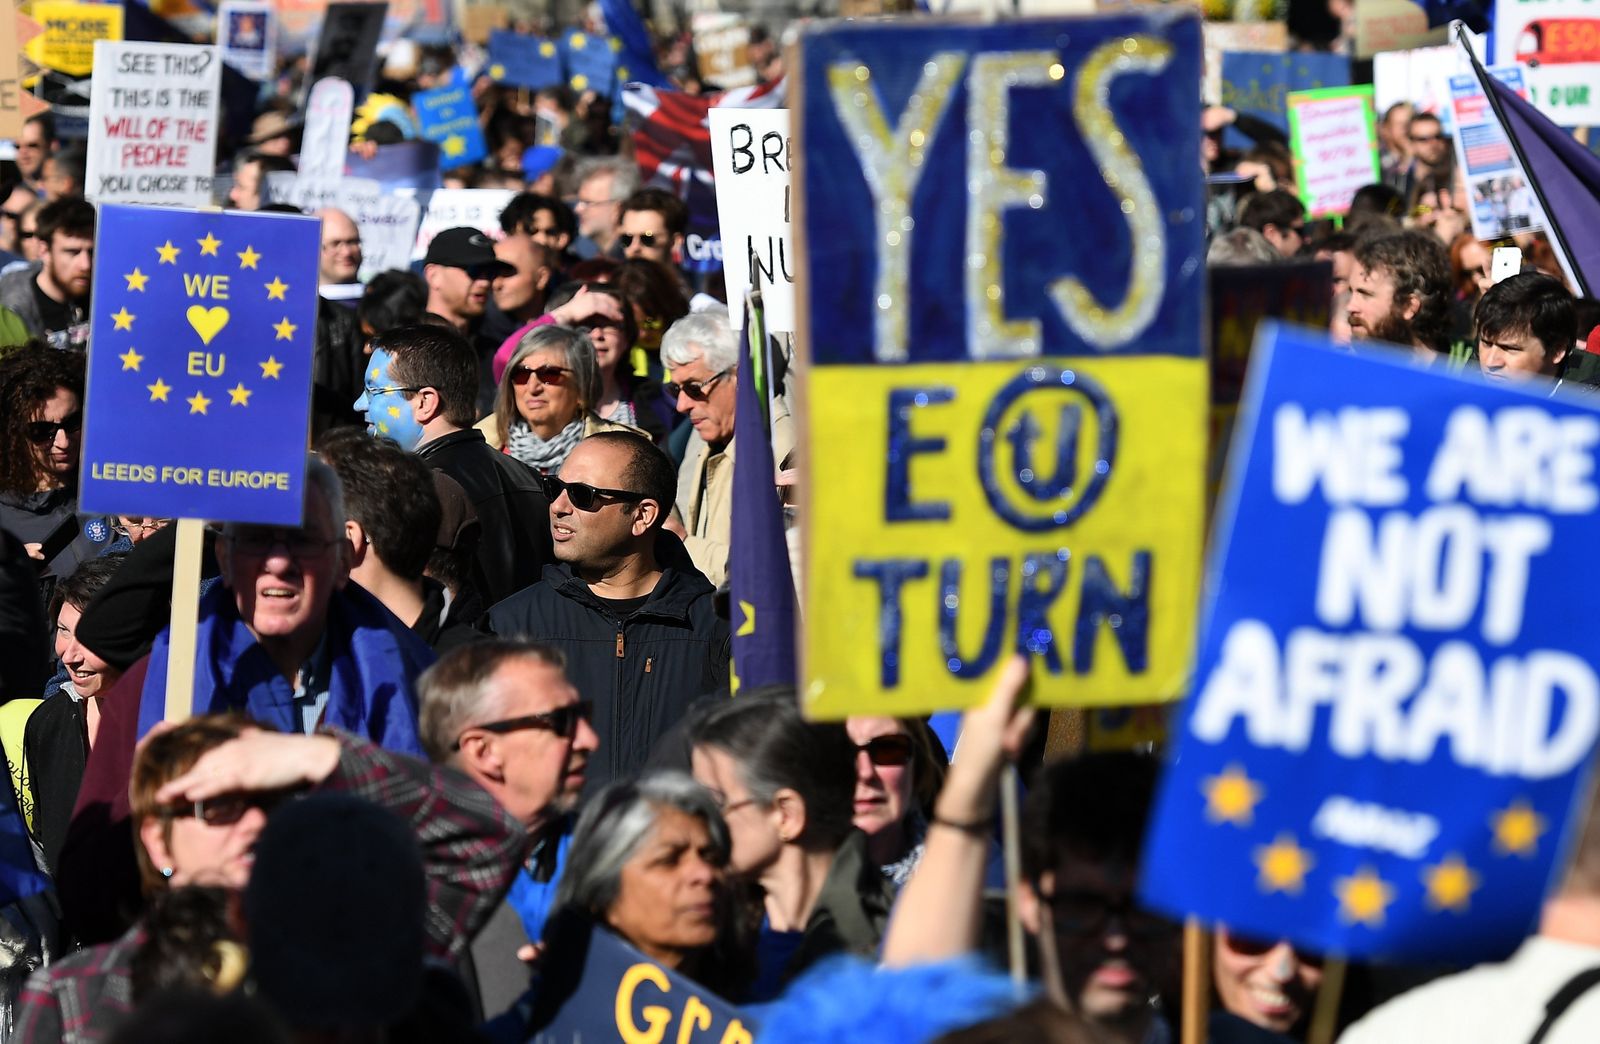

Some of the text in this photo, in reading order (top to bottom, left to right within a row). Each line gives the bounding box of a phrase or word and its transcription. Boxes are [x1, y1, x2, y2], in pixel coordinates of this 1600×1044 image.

[117, 52, 156, 74] SEE
[162, 50, 212, 76] THIS?
[110, 86, 211, 109] THIS IS THE
[104, 115, 142, 139] WILL
[146, 116, 171, 139] OF
[175, 118, 208, 142] THE
[121, 142, 189, 169] PEOPLE
[99, 174, 214, 195] YOU CHOSE TO
[827, 35, 1175, 361] YES
[183, 274, 230, 299] WE
[187, 351, 226, 377] EU
[1272, 401, 1600, 513] WE ARE
[92, 463, 290, 490] LEEDS FOR EUROPE
[1315, 503, 1552, 646] NOT
[852, 550, 1153, 689] TURN
[1191, 620, 1600, 778] AFRAID
